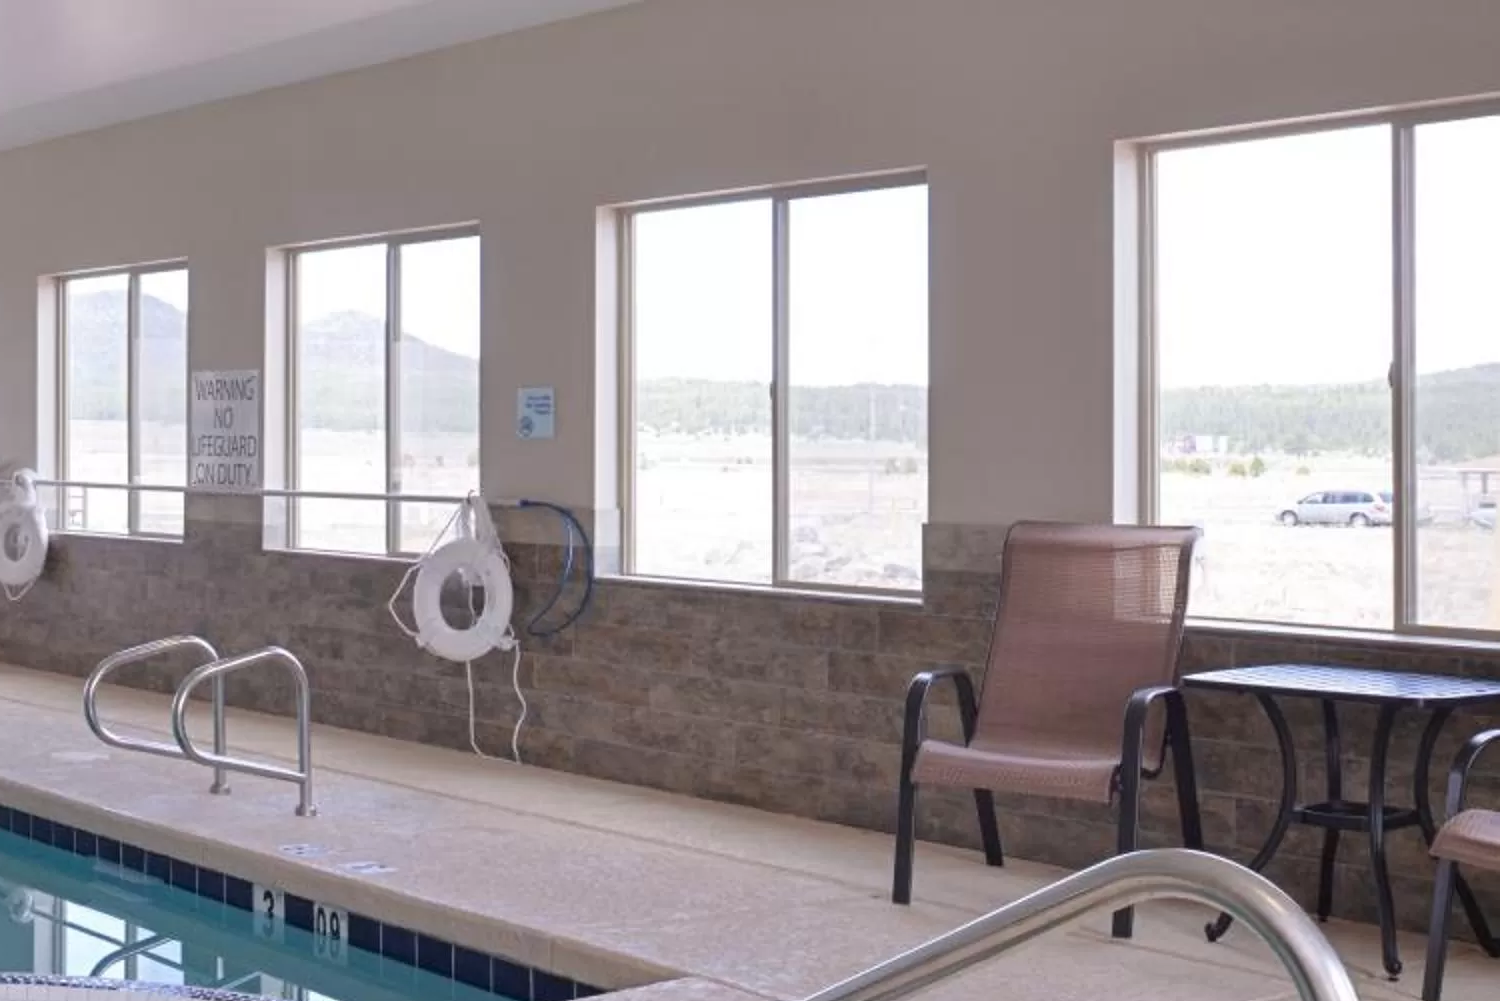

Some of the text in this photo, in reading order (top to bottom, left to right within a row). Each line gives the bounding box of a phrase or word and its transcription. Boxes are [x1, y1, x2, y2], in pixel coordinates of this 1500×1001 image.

[194, 375, 257, 401] WARNING
[213, 406, 233, 429] NO
[192, 434, 257, 457] LIFEGUARD
[195, 462, 253, 485] ON DUTY
